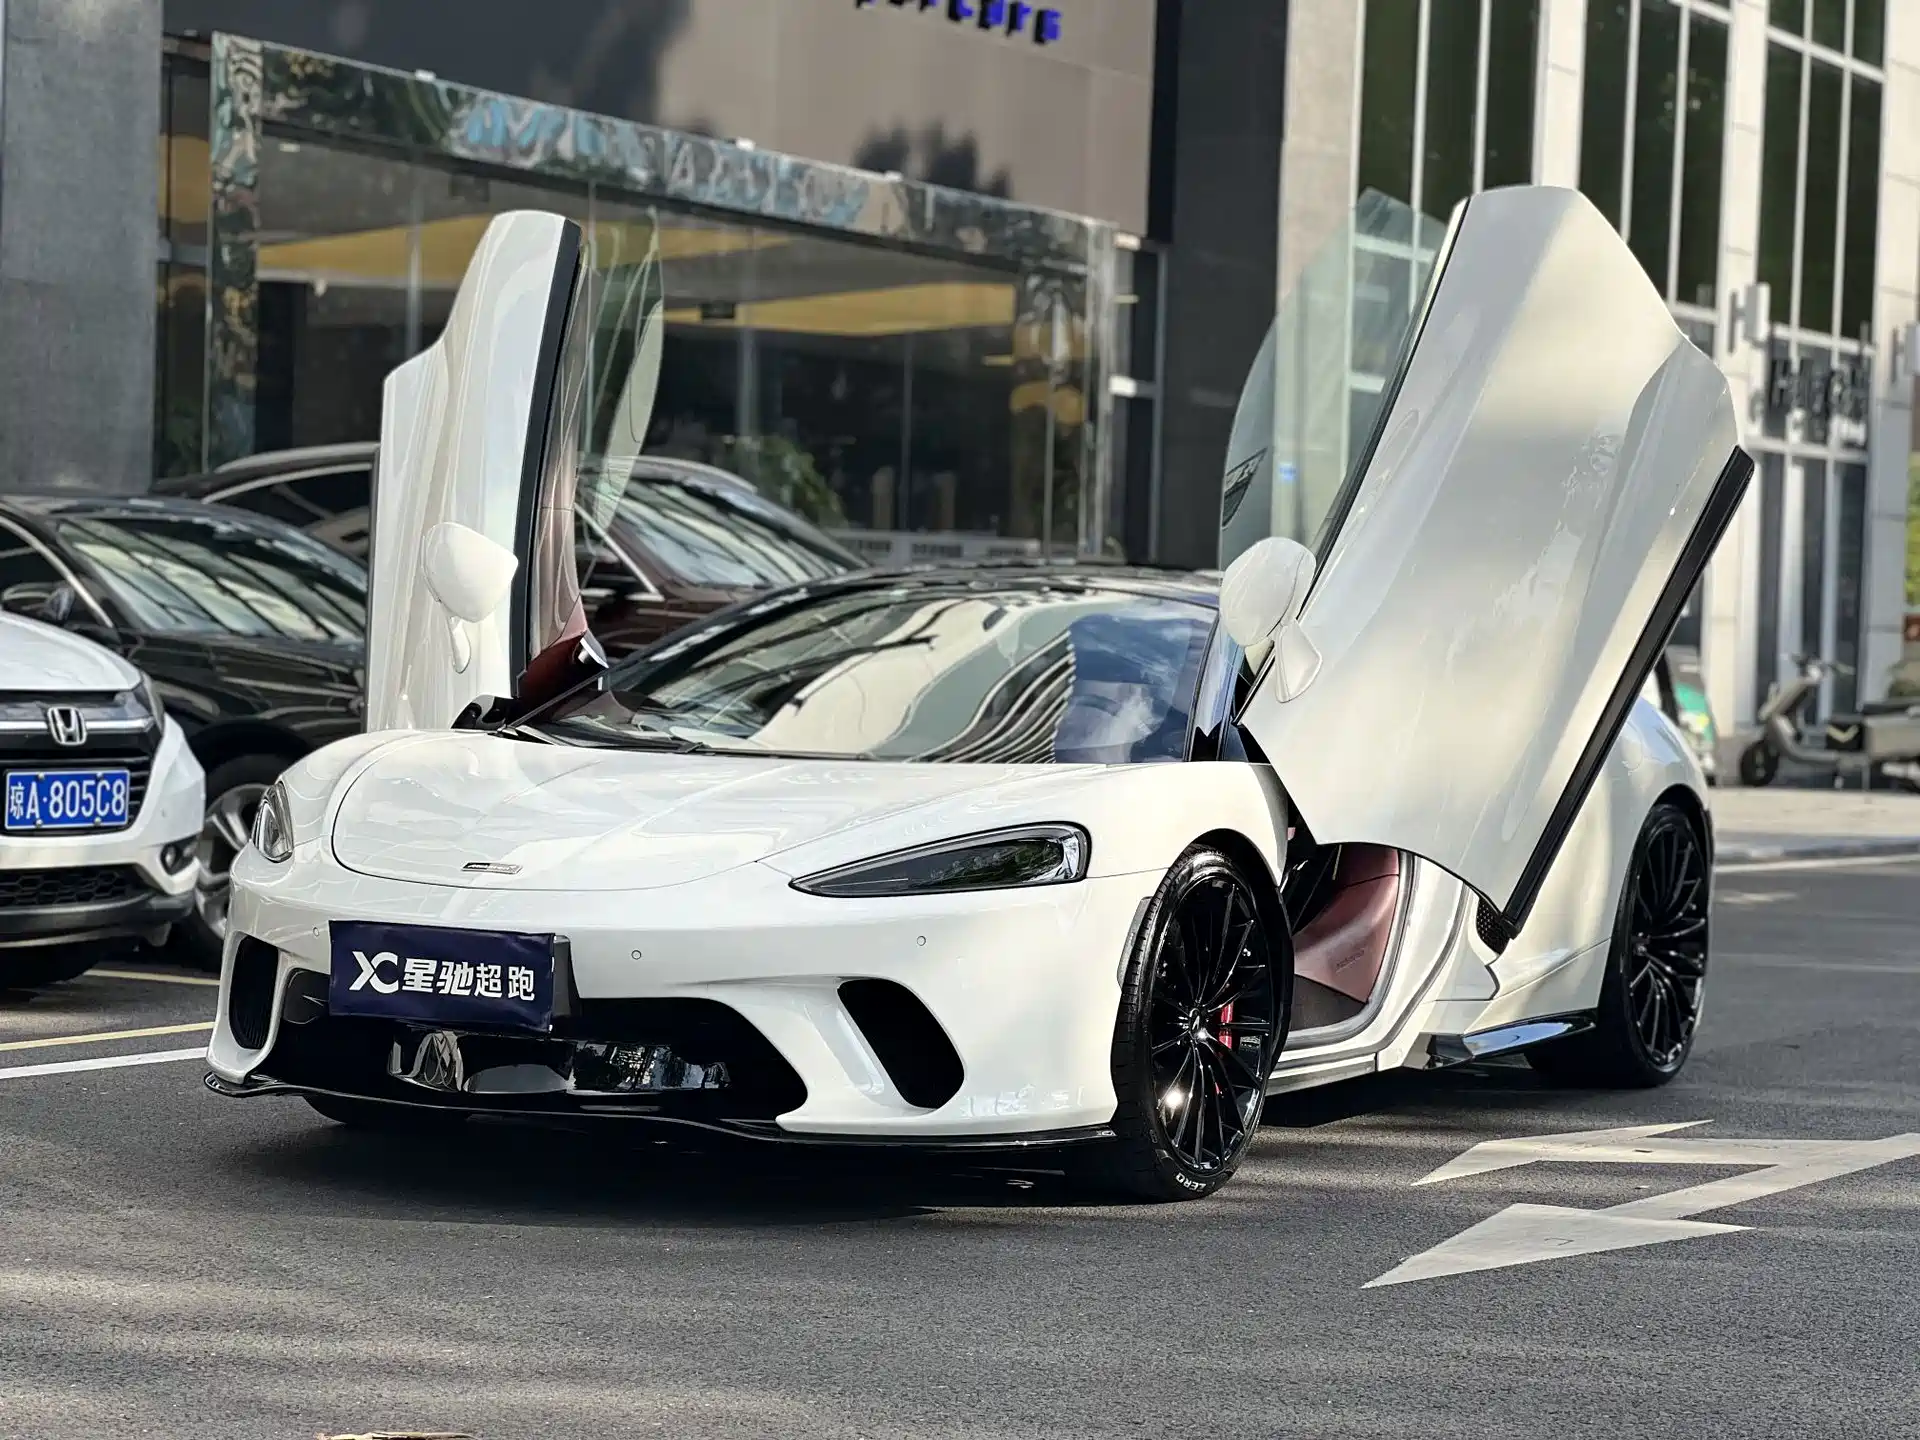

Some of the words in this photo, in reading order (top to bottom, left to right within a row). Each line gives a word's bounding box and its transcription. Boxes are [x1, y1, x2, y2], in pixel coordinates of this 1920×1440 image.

[10, 779, 125, 819] 琼A·805C8
[402, 957, 536, 1001] 星驰超跑
